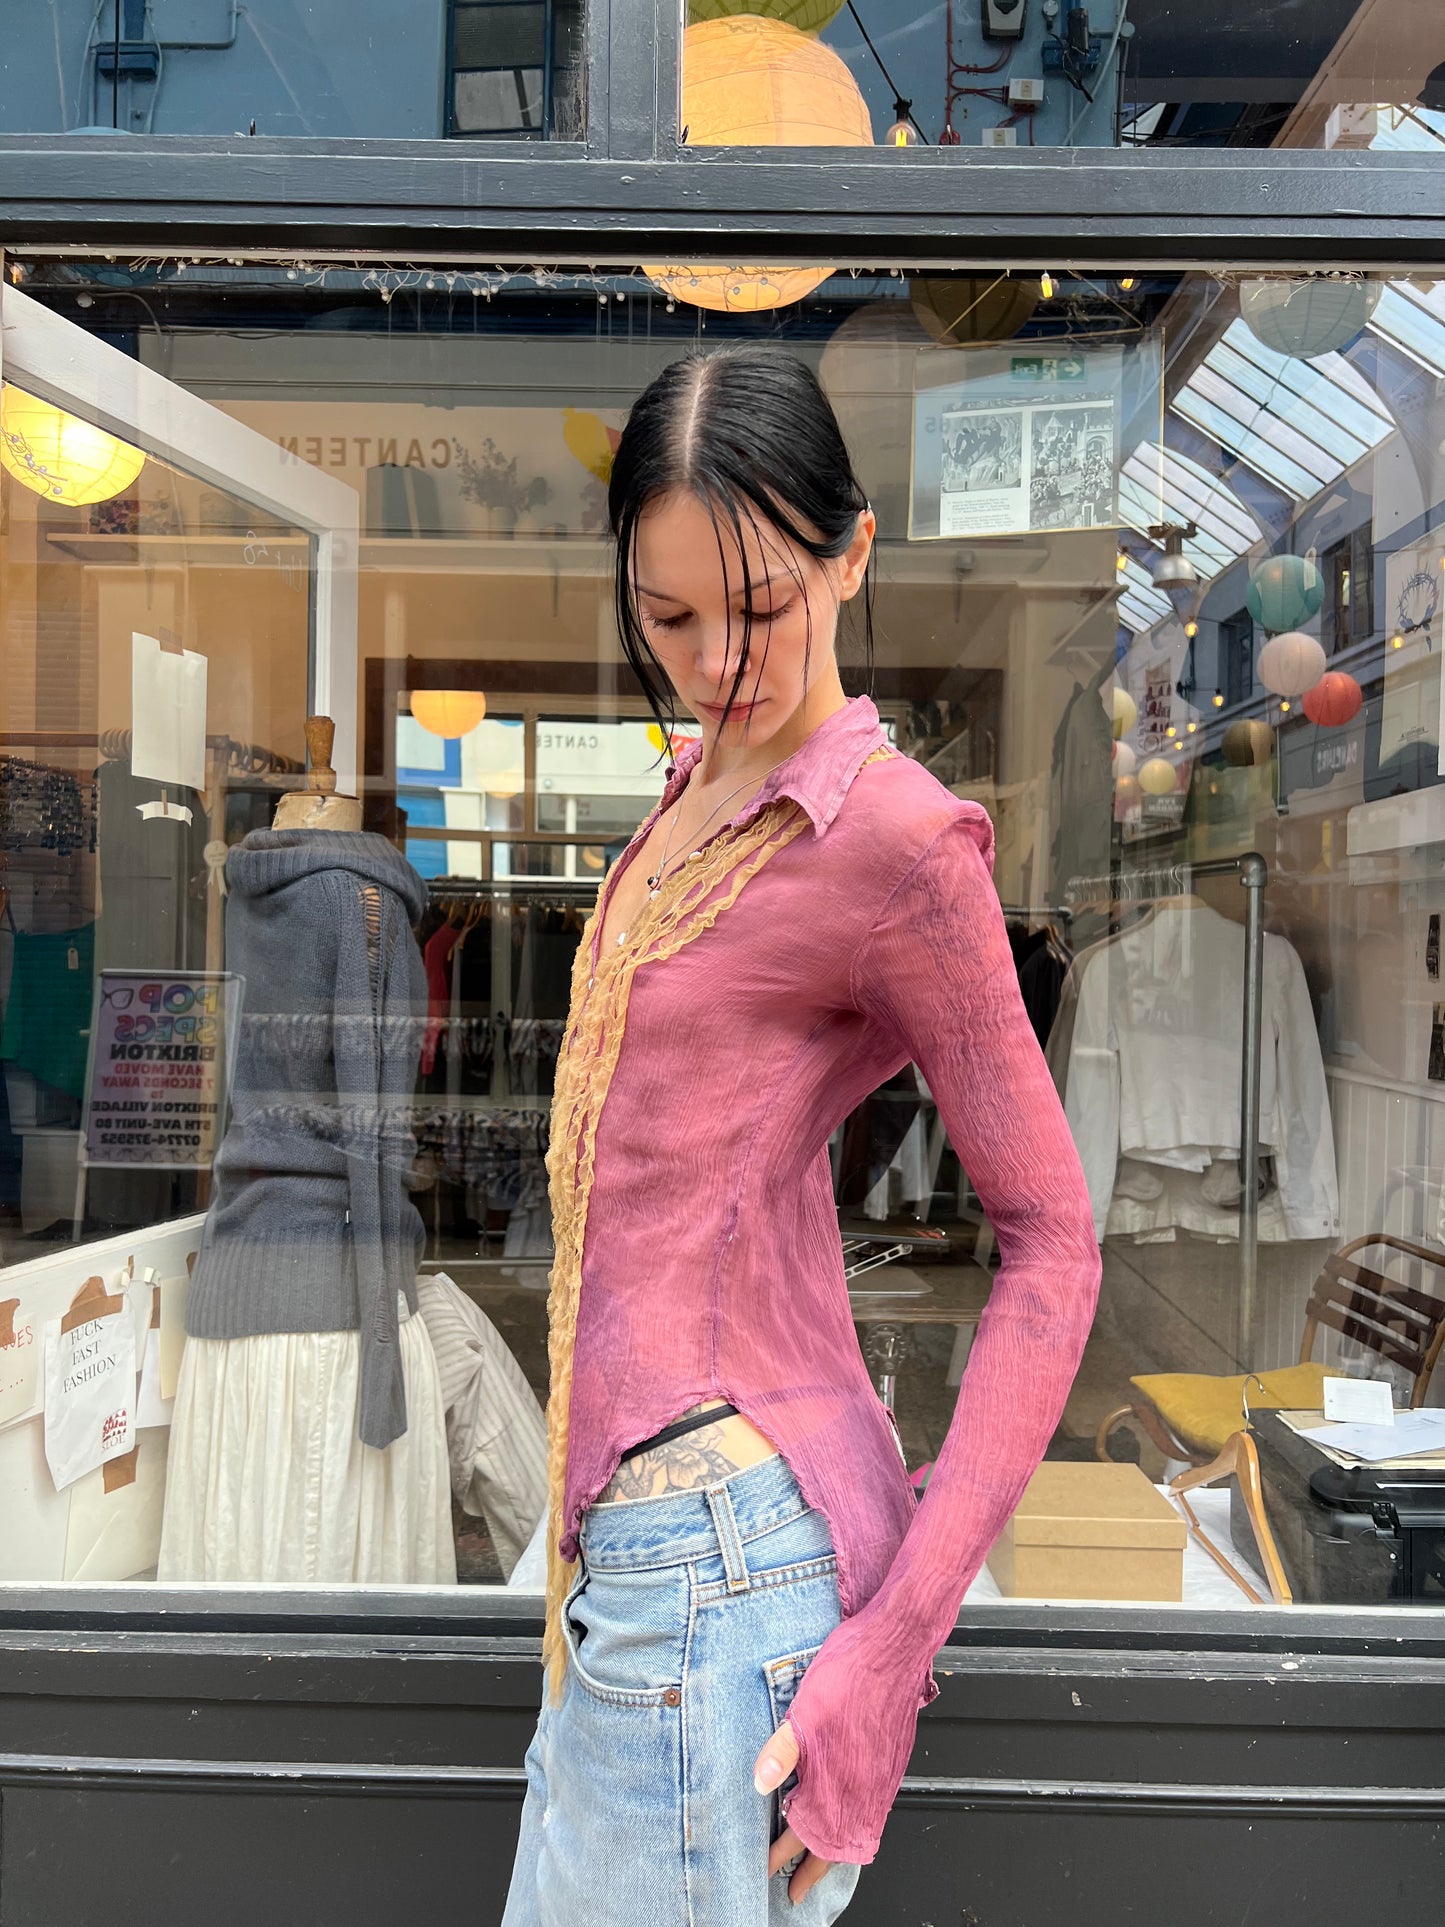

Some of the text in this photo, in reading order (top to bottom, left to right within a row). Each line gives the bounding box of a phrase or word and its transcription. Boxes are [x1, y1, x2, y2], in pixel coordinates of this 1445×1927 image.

[69, 1318, 105, 1346] FUCK
[72, 1339, 102, 1366] FAST
[62, 1354, 117, 1394] FASHION
